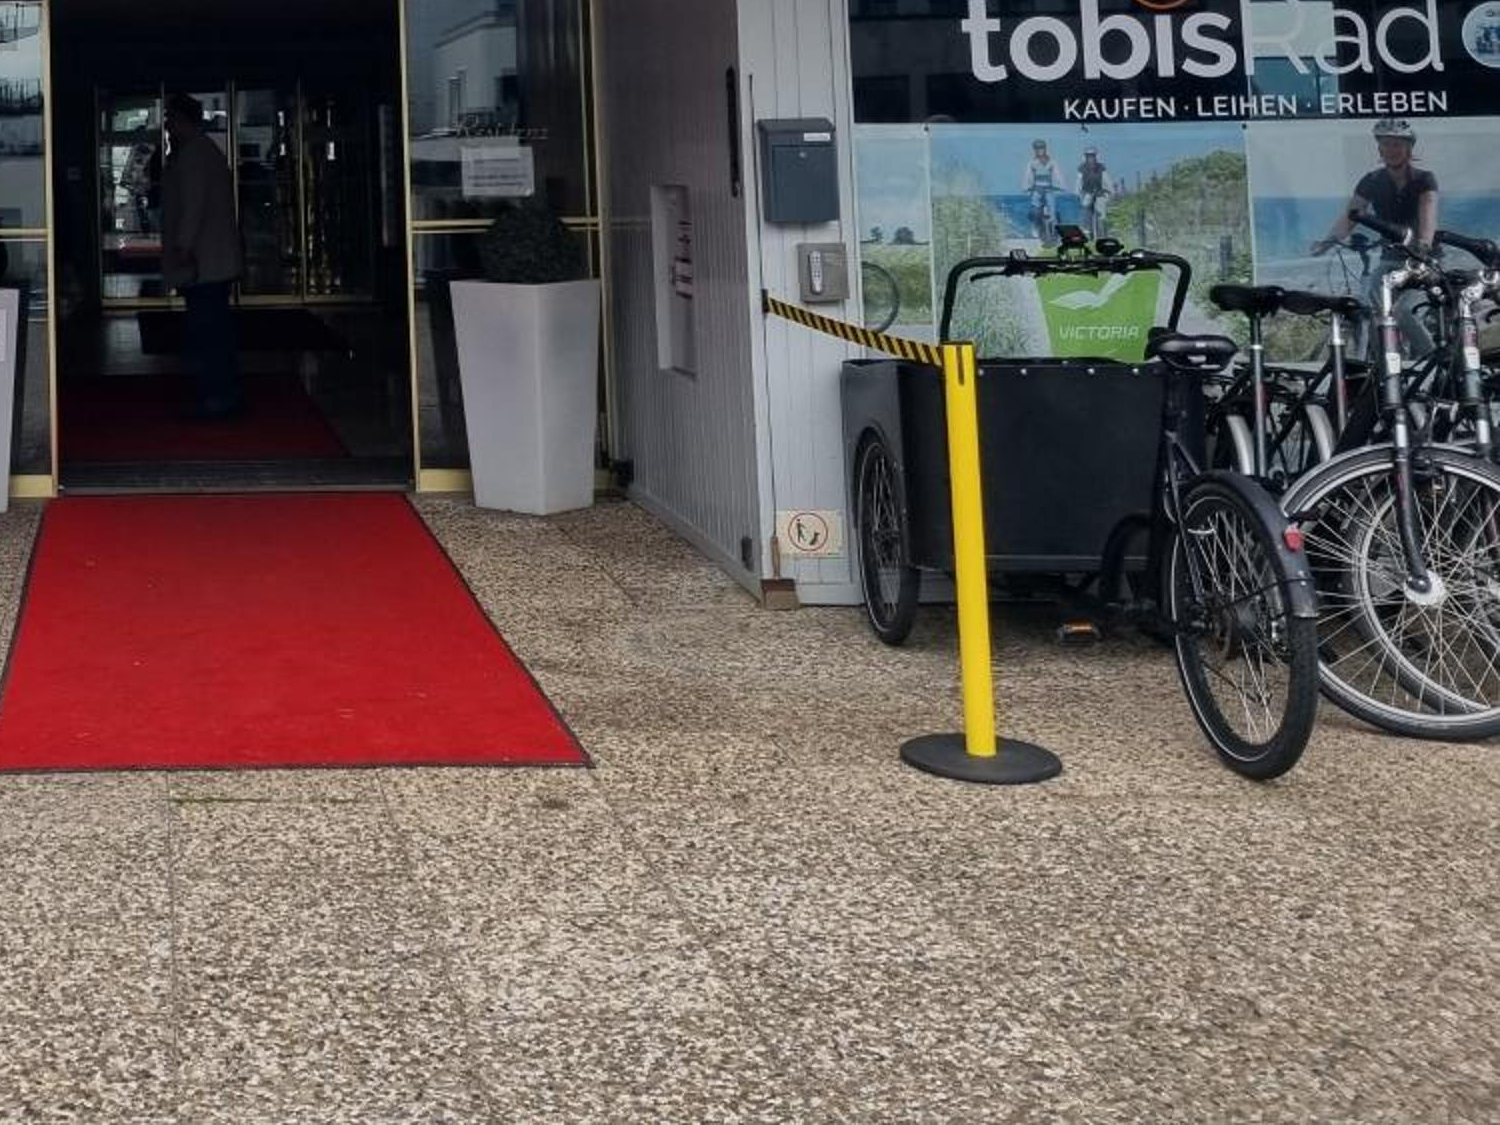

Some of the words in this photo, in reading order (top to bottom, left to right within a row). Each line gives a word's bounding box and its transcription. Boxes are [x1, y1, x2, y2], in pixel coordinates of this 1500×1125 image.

[1063, 97, 1176, 120] KAUFEN
[1197, 95, 1298, 117] LEIHEN
[1320, 91, 1448, 115] ERLEBEN
[1059, 325, 1141, 341] VICTORIA
